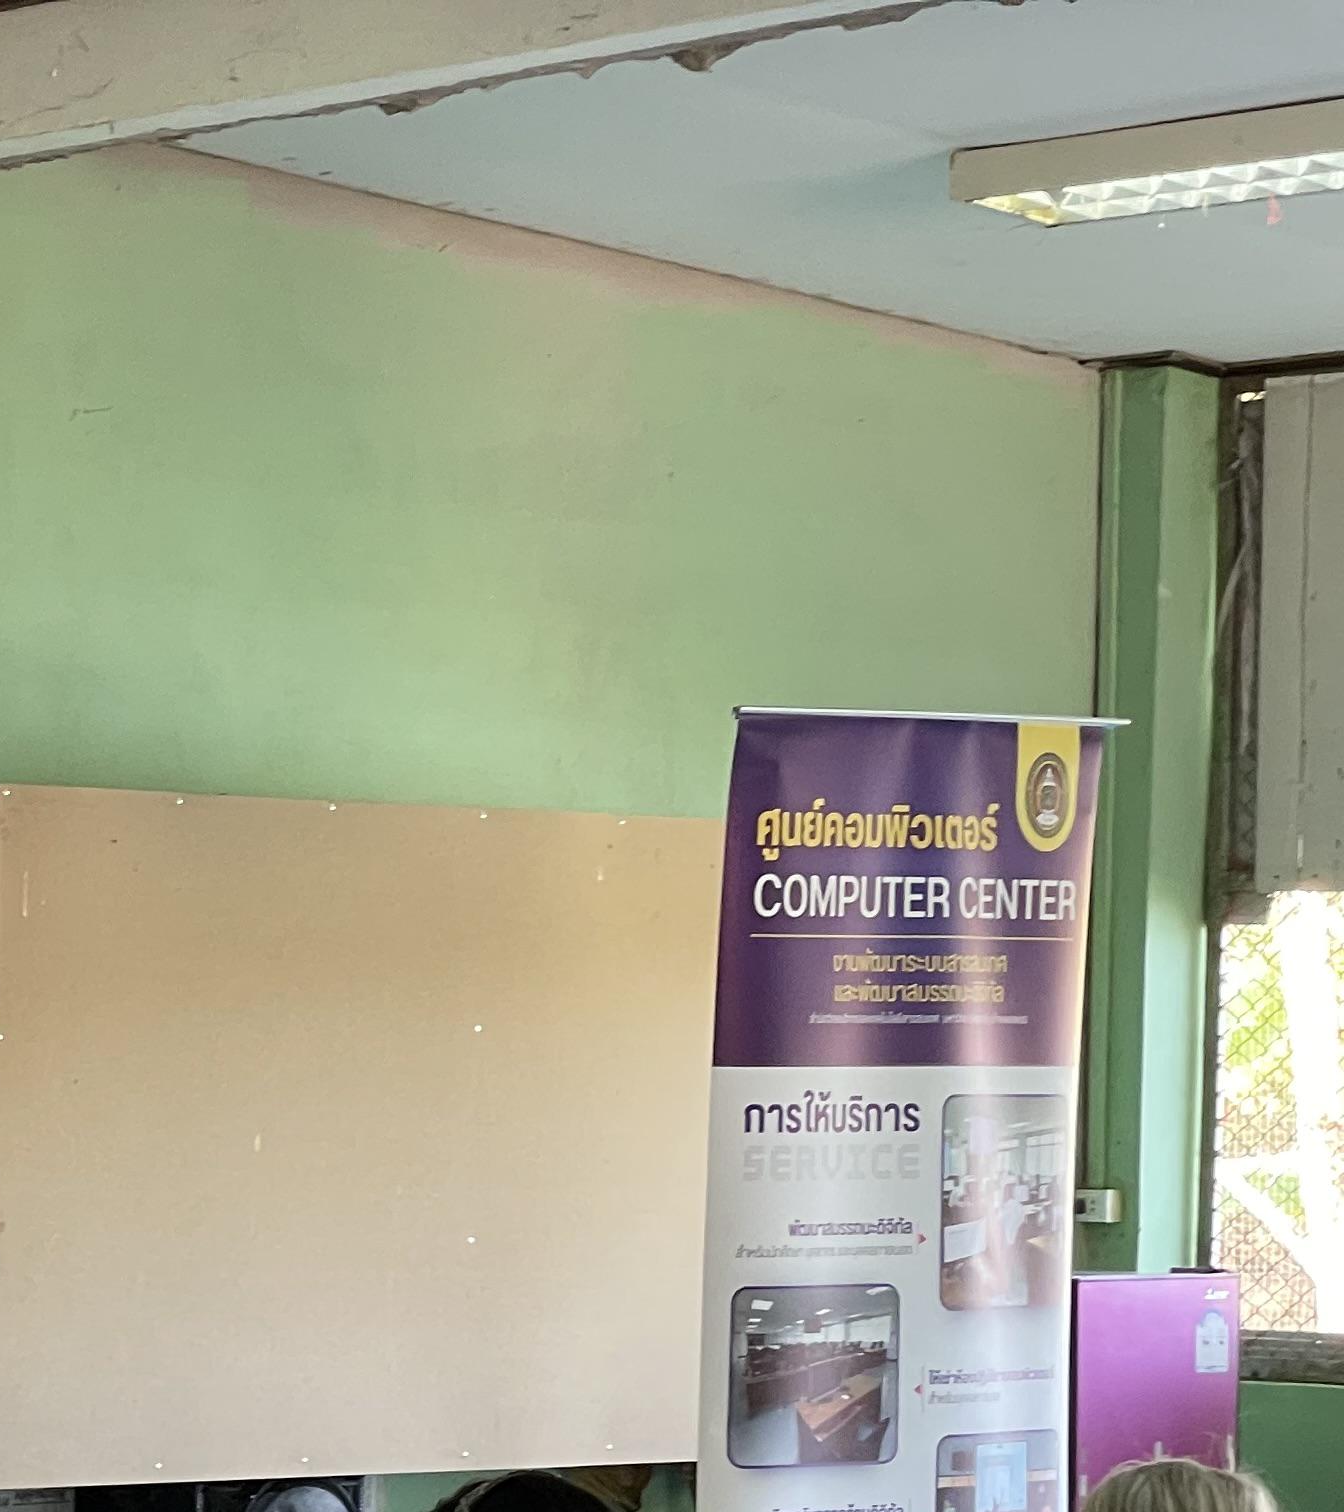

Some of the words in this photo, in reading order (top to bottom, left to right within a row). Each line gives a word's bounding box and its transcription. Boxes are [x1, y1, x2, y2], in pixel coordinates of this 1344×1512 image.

[756, 798, 1000, 861] ศูนย์คอมพิวเตอร์
[753, 873, 950, 918] COMPUTER
[959, 877, 1076, 921] CENTER
[744, 1089, 921, 1133] การให้บริการ
[743, 1143, 921, 1181] SERVICE
